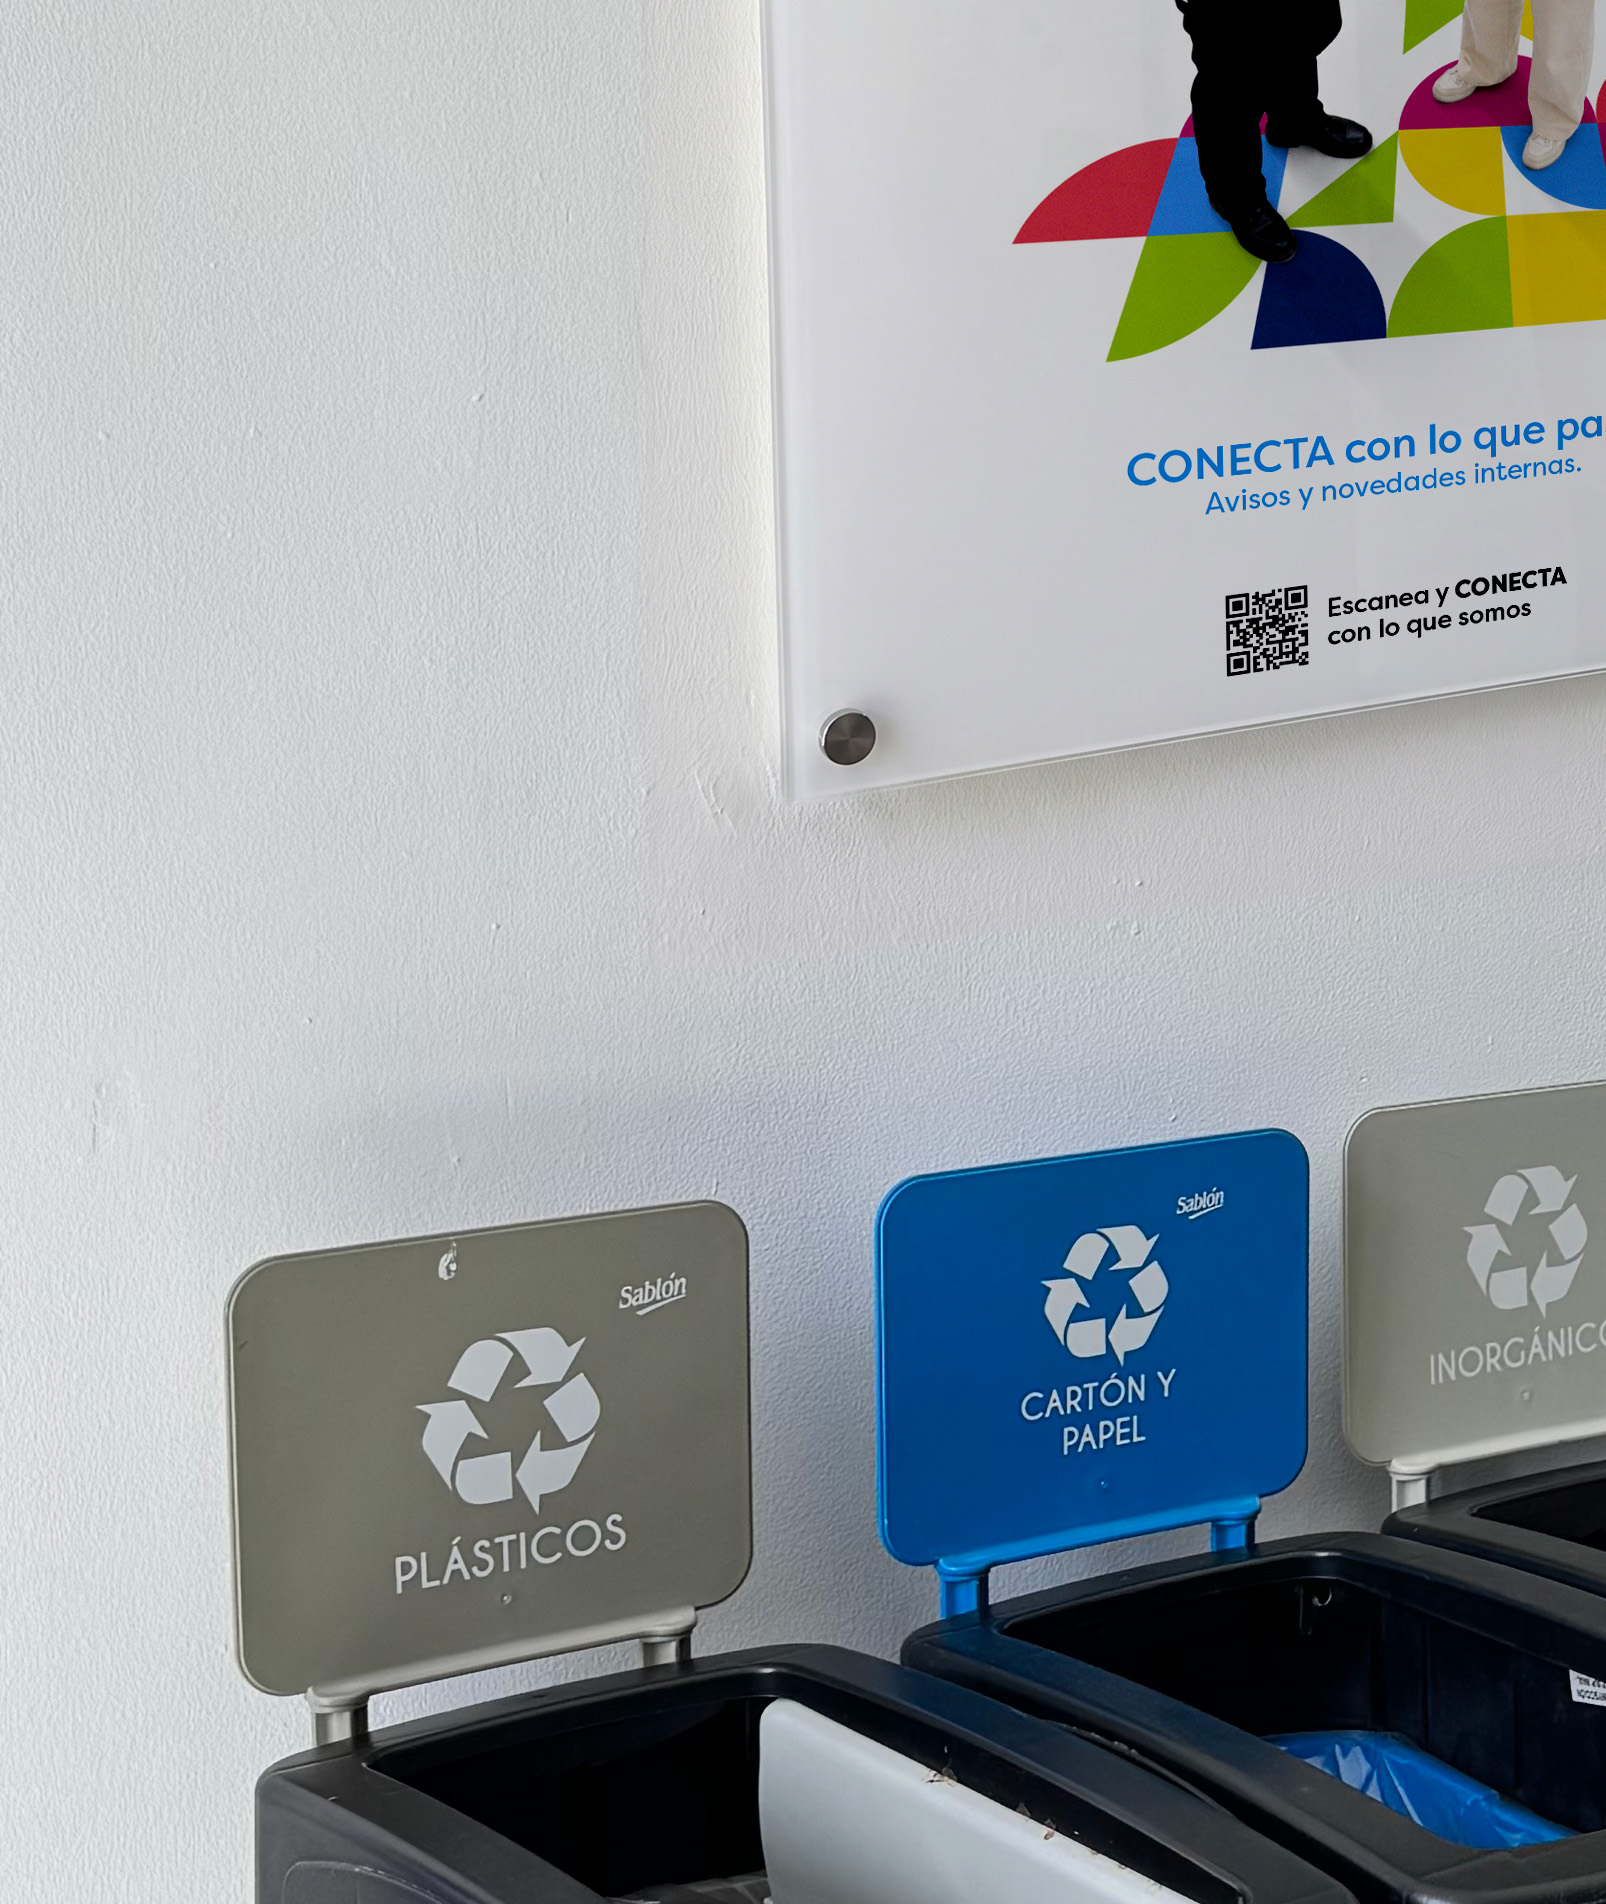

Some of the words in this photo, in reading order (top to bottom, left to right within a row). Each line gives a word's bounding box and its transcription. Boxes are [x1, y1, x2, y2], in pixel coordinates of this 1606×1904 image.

[1128, 436, 1334, 486] CONECTA
[1346, 435, 1415, 463] con
[1430, 424, 1461, 454] lo
[1474, 422, 1545, 457] que
[1206, 489, 1290, 514] Avisos
[1299, 487, 1313, 510] y
[1323, 468, 1465, 501] novedades
[1475, 458, 1581, 483] internas.
[1329, 590, 1428, 617] Escanea
[1435, 587, 1449, 607] y
[1455, 567, 1567, 598] CONECTA
[1328, 626, 1370, 644] con
[1380, 619, 1400, 637] lo
[1407, 615, 1451, 638] que
[1459, 603, 1531, 625] somos
[1177, 1187, 1223, 1214] Sablón
[619, 1272, 686, 1308] Sablón
[1021, 1373, 1144, 1420] CARTÓN
[1157, 1369, 1175, 1397] Y
[1064, 1416, 1145, 1455] PAPEL
[395, 1514, 626, 1594] PLÁSTICOS
